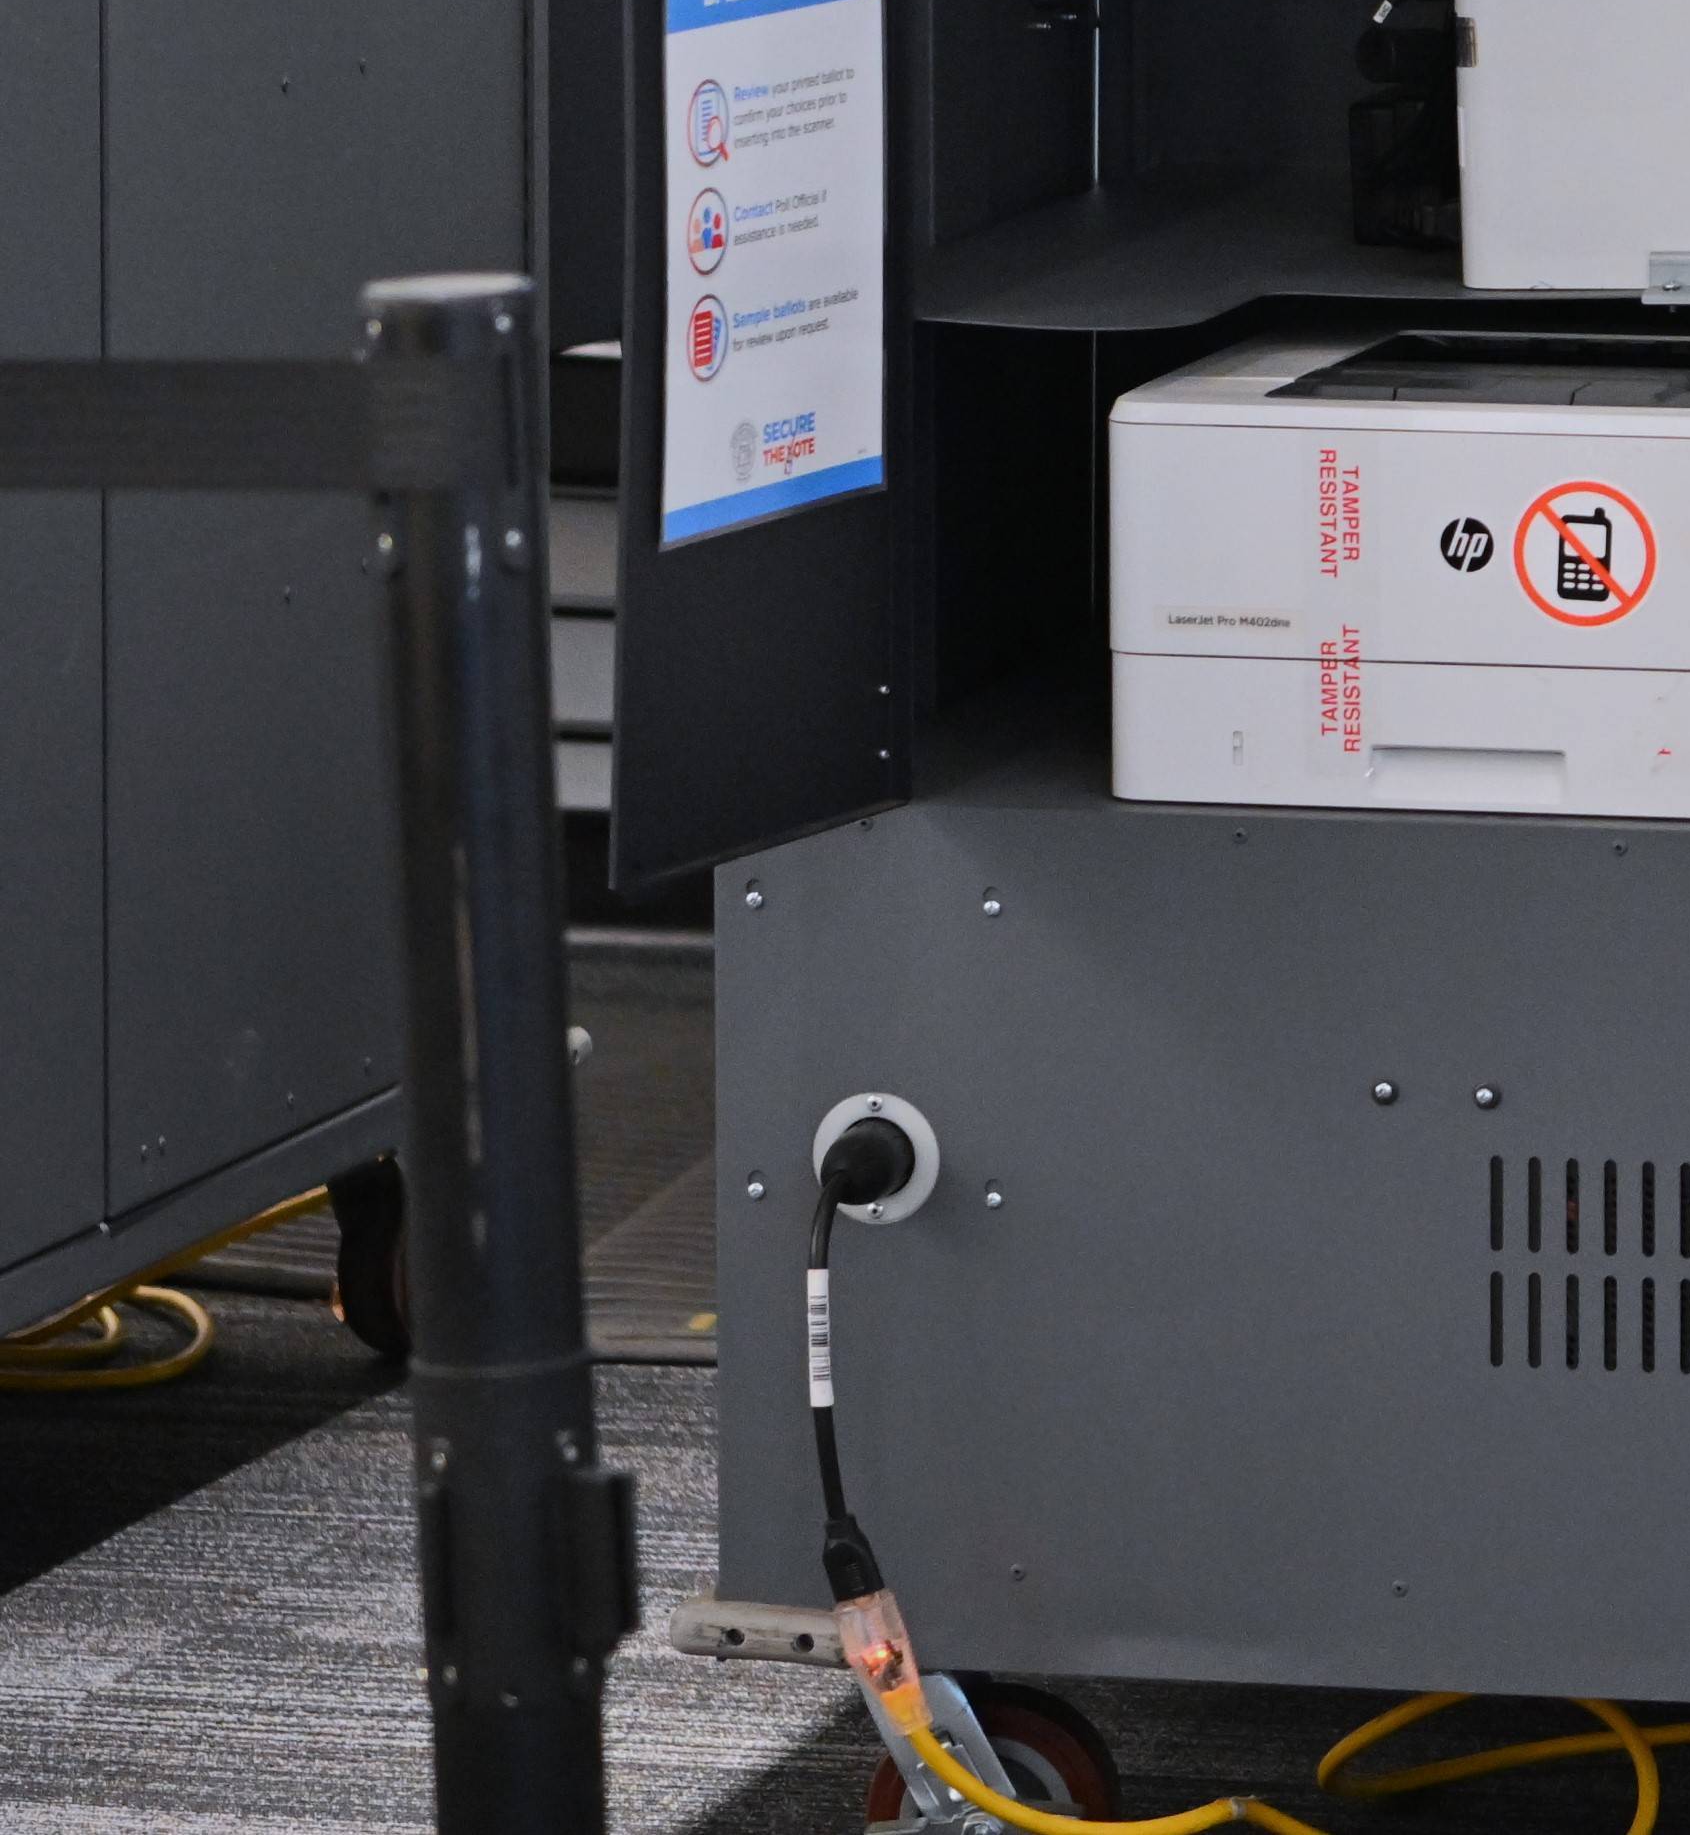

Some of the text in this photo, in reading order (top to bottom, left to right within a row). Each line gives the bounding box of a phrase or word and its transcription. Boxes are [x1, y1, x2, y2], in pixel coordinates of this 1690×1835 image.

[734, 82, 768, 100] Review
[772, 80, 789, 98] your
[792, 75, 819, 92] printed
[734, 92, 847, 126] confirm your choices prior to
[734, 132, 768, 152] inserting
[734, 201, 772, 222] Contact
[775, 197, 789, 213] Poll
[733, 227, 775, 246] assistance
[733, 289, 858, 332] Sample ballots are available
[746, 333, 773, 348] review
[775, 327, 797, 342] upon
[762, 412, 815, 444] SECURE
[762, 445, 784, 466] THE
[1320, 450, 1338, 578] RESISTANT
[1342, 466, 1360, 562] TAMPER
[1440, 517, 1494, 572] hp
[1168, 613, 1214, 626] LaserJet
[1218, 615, 1236, 626] Pro
[1321, 641, 1338, 737] TAMPER
[1343, 624, 1360, 753] RESISTANT
